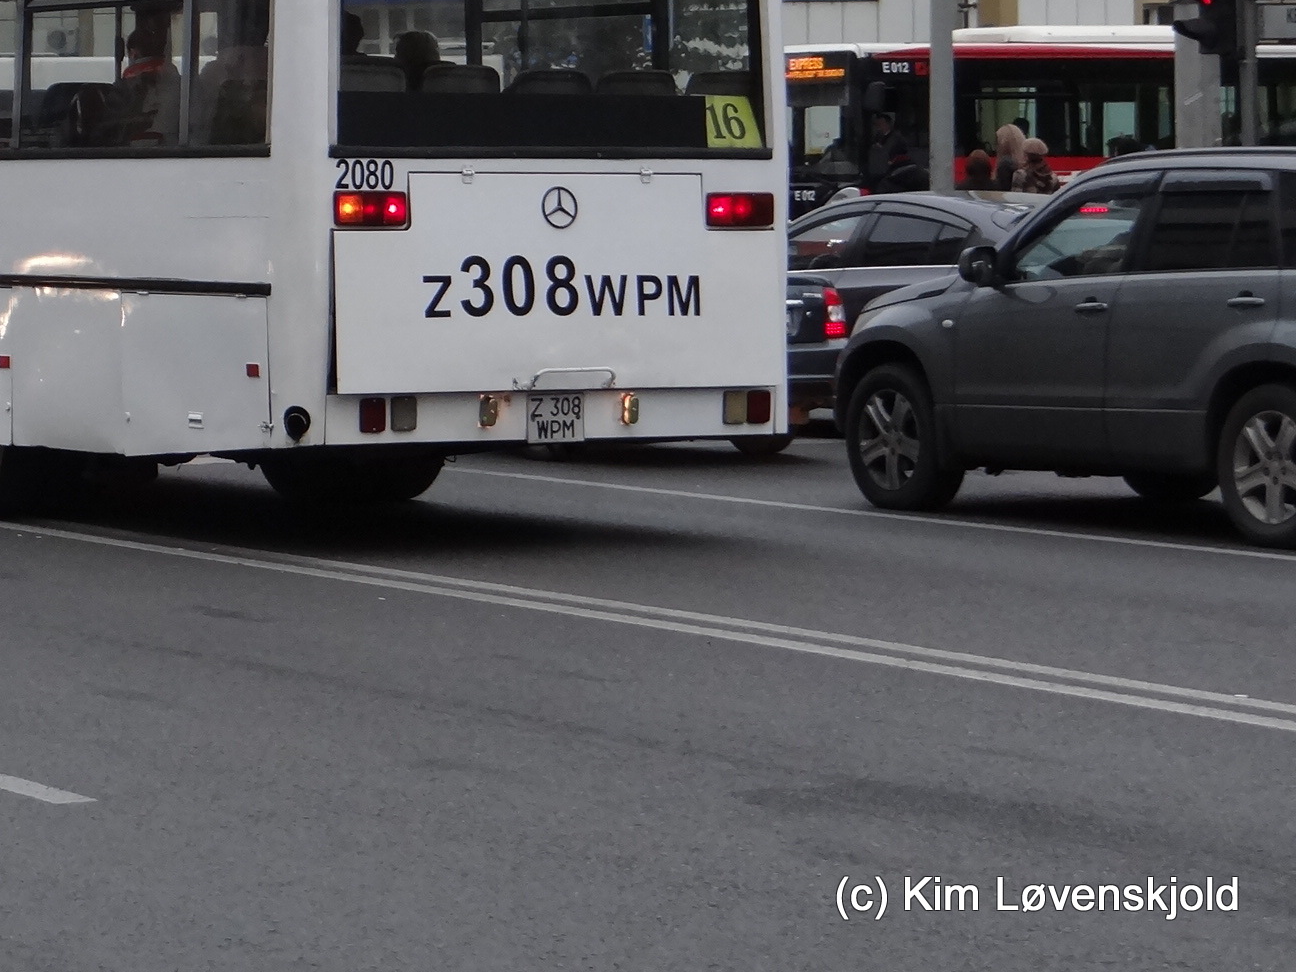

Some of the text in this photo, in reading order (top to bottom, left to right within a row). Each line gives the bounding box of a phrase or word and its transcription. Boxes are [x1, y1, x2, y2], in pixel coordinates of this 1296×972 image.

[705, 103, 746, 139] 16
[335, 158, 394, 190] 2080
[536, 419, 575, 439] WPM
